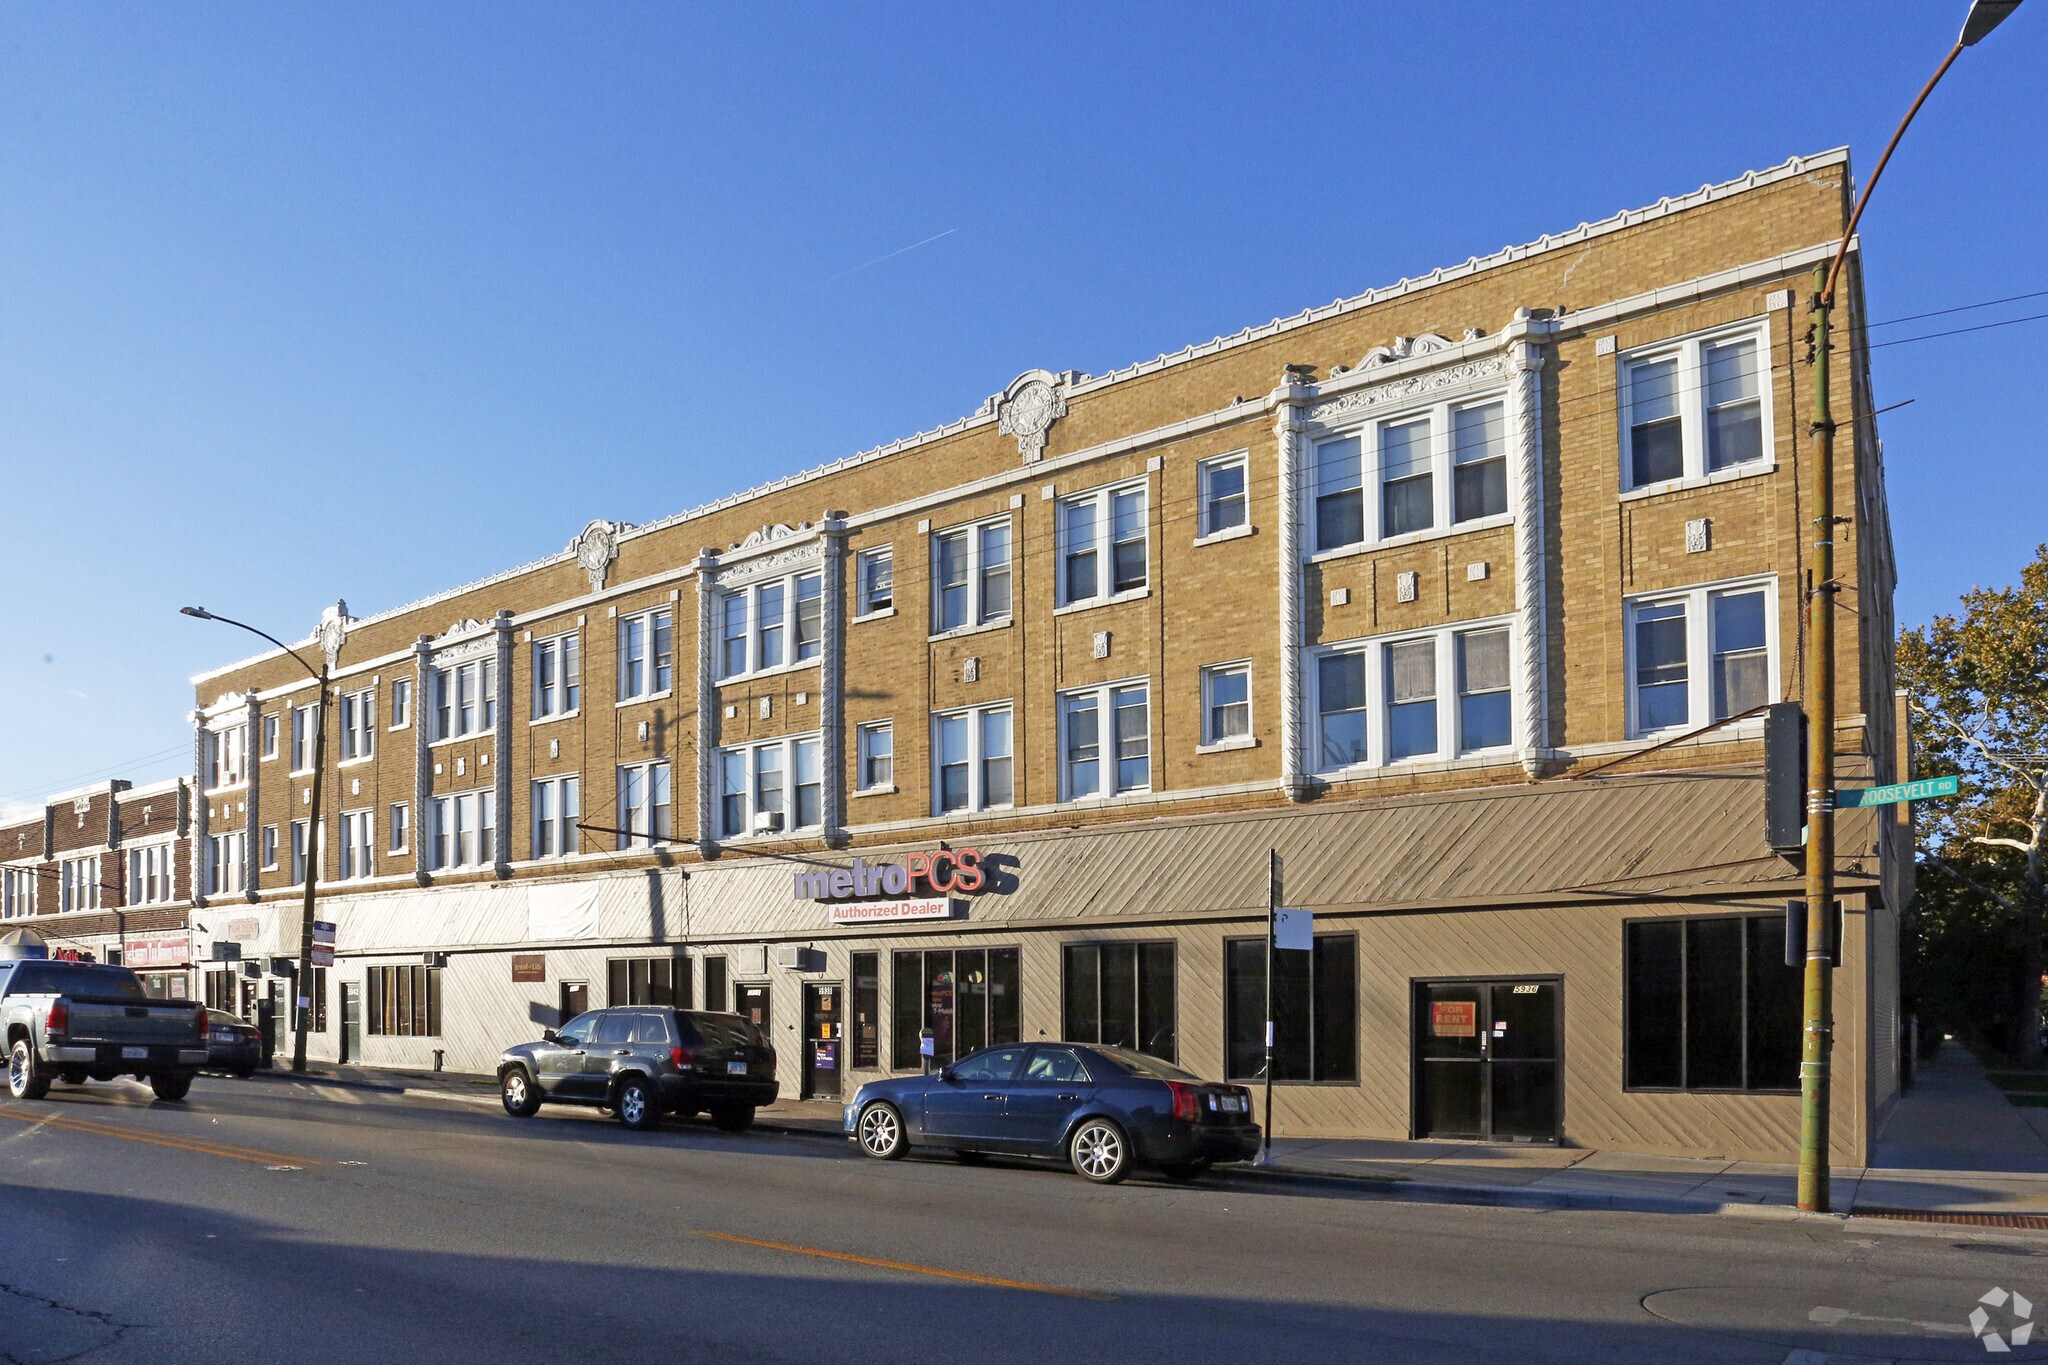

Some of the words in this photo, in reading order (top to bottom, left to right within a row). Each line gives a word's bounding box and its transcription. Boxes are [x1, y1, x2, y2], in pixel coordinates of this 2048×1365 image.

[1860, 781, 1935, 805] ROOSEVELT
[1938, 781, 1952, 791] RD
[793, 848, 986, 900] metroPCS
[833, 903, 899, 919] Authorized
[901, 901, 944, 916] Dealer
[1515, 985, 1537, 993] 5936
[1440, 1005, 1464, 1014] FOR
[1436, 1014, 1468, 1024] RENT
